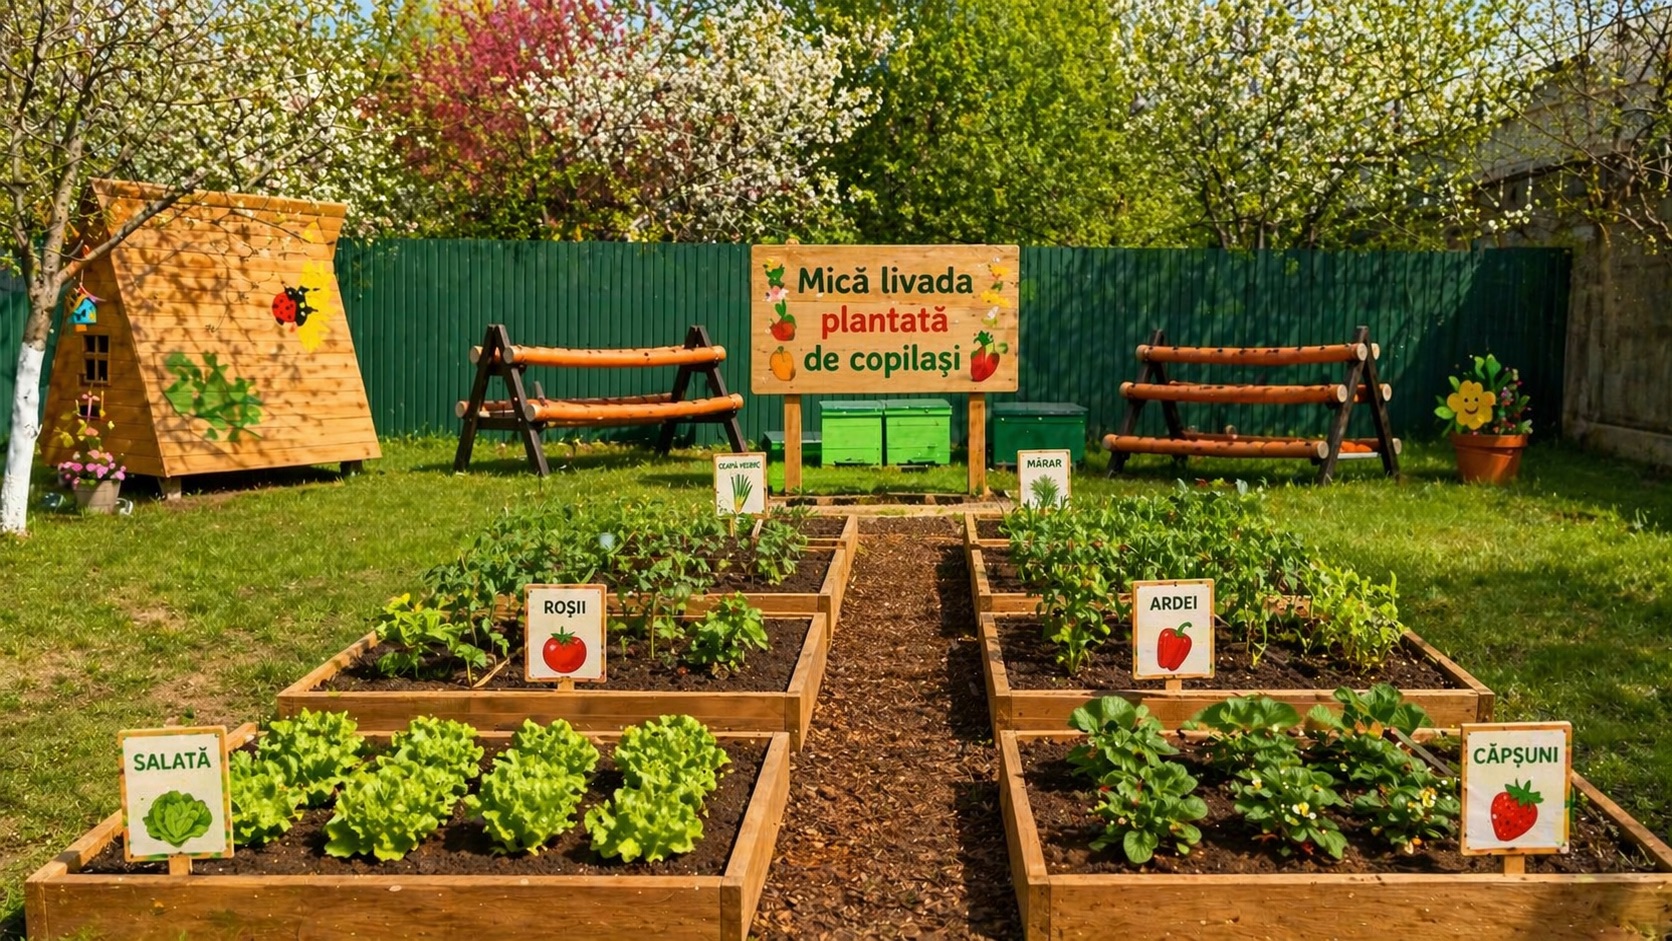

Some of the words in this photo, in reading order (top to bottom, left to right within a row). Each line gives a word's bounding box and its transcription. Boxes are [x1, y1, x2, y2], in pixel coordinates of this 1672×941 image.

[798, 266, 869, 294] Mică
[881, 266, 973, 294] livada
[821, 305, 948, 340] plantată
[804, 345, 839, 371] de
[1150, 595, 1197, 611] ARDEI
[133, 746, 211, 771] SALATĂ
